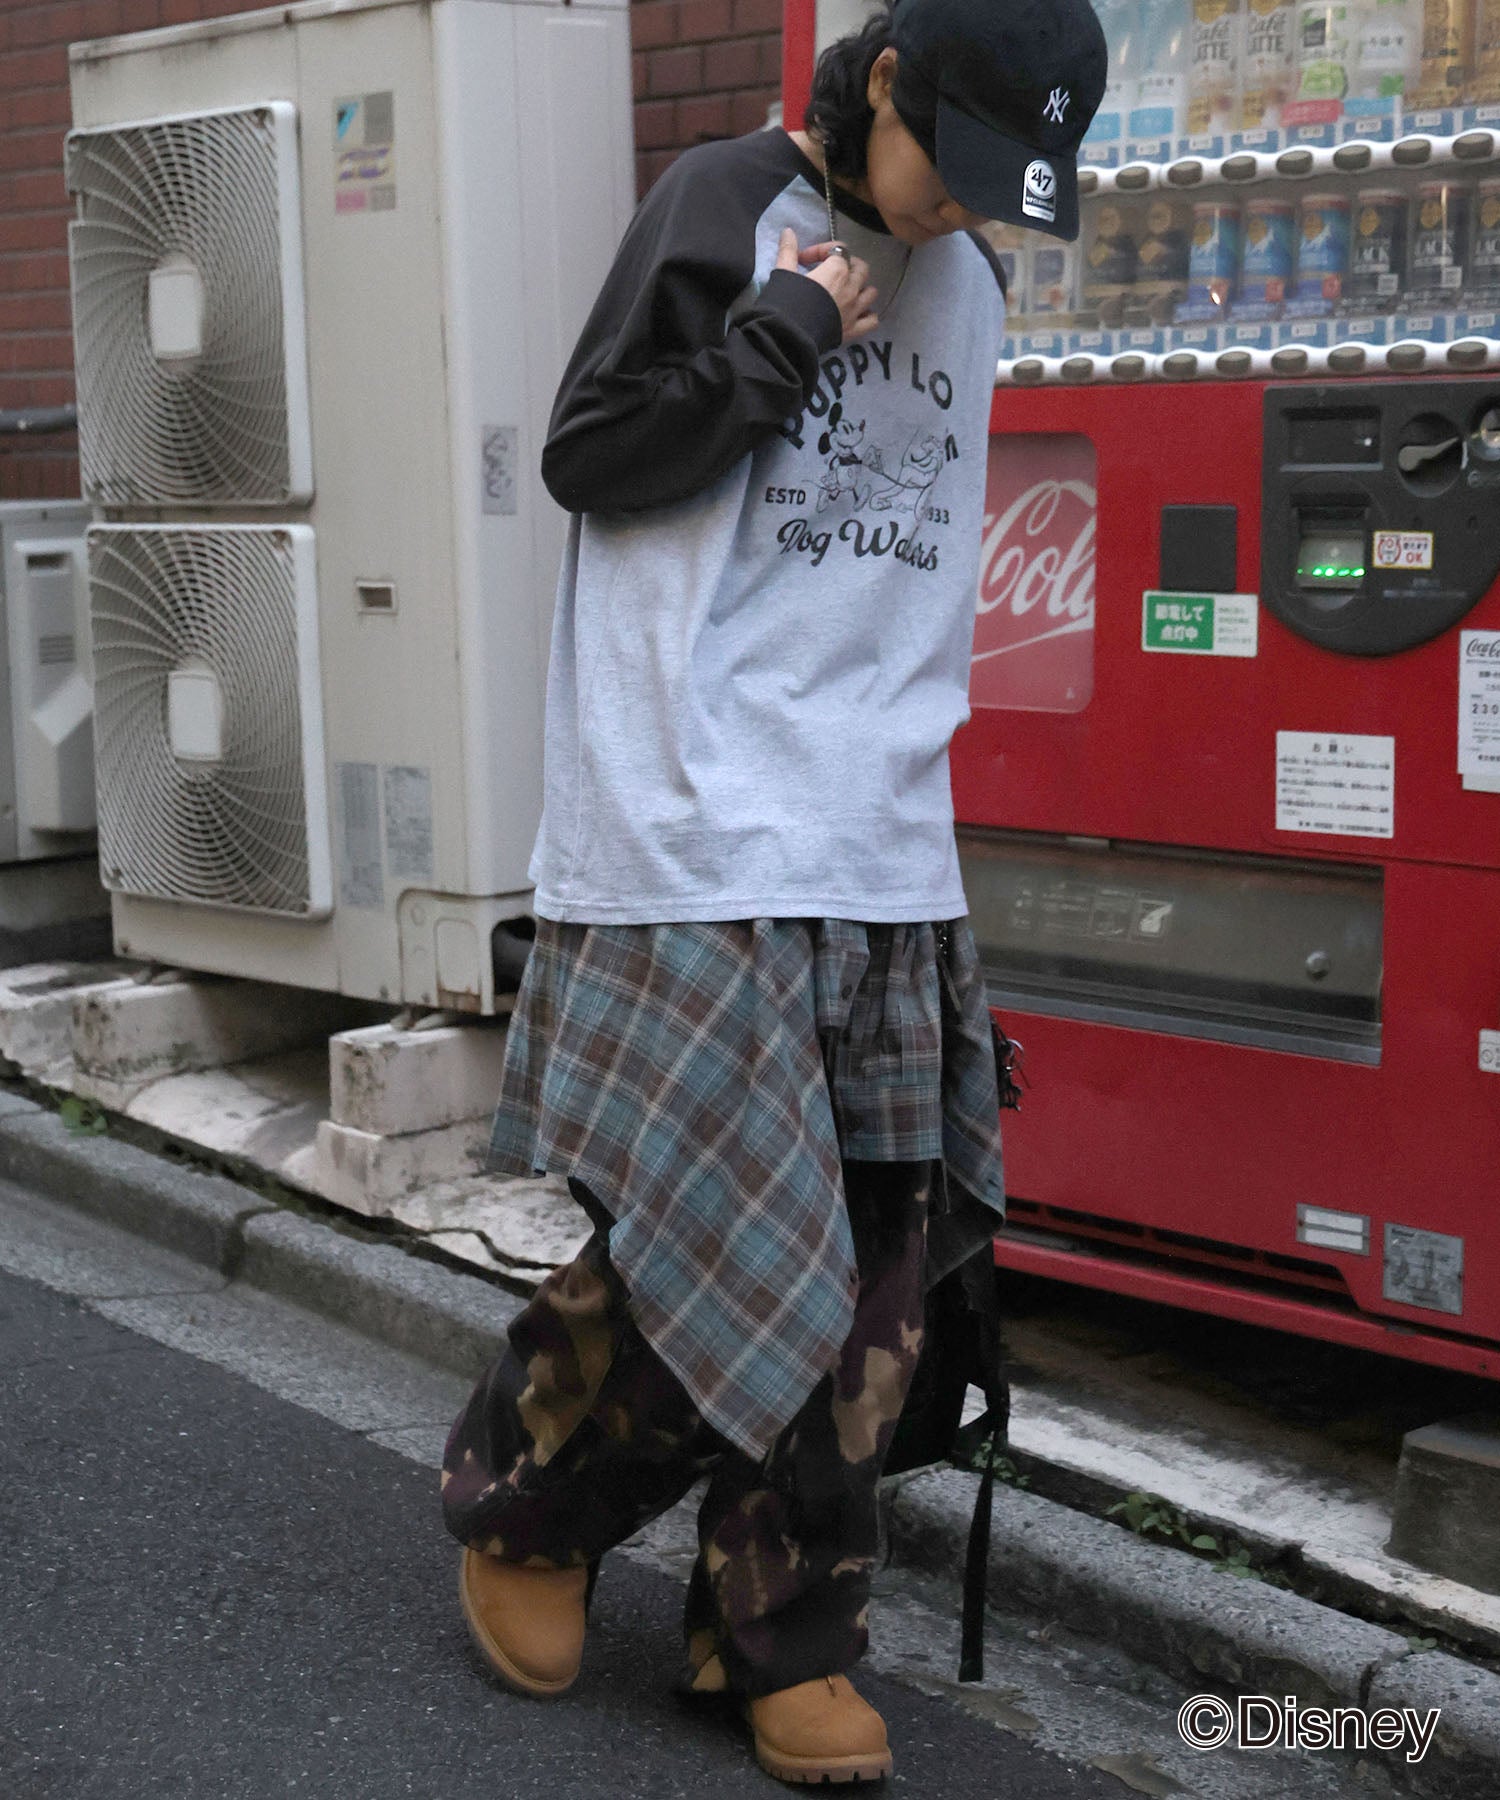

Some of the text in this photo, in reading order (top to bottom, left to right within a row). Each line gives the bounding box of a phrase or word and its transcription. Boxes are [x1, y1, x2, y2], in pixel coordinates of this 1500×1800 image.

[764, 486, 806, 505] ESTD
[777, 518, 832, 567] Dog
[1405, 552, 1423, 563] OK
